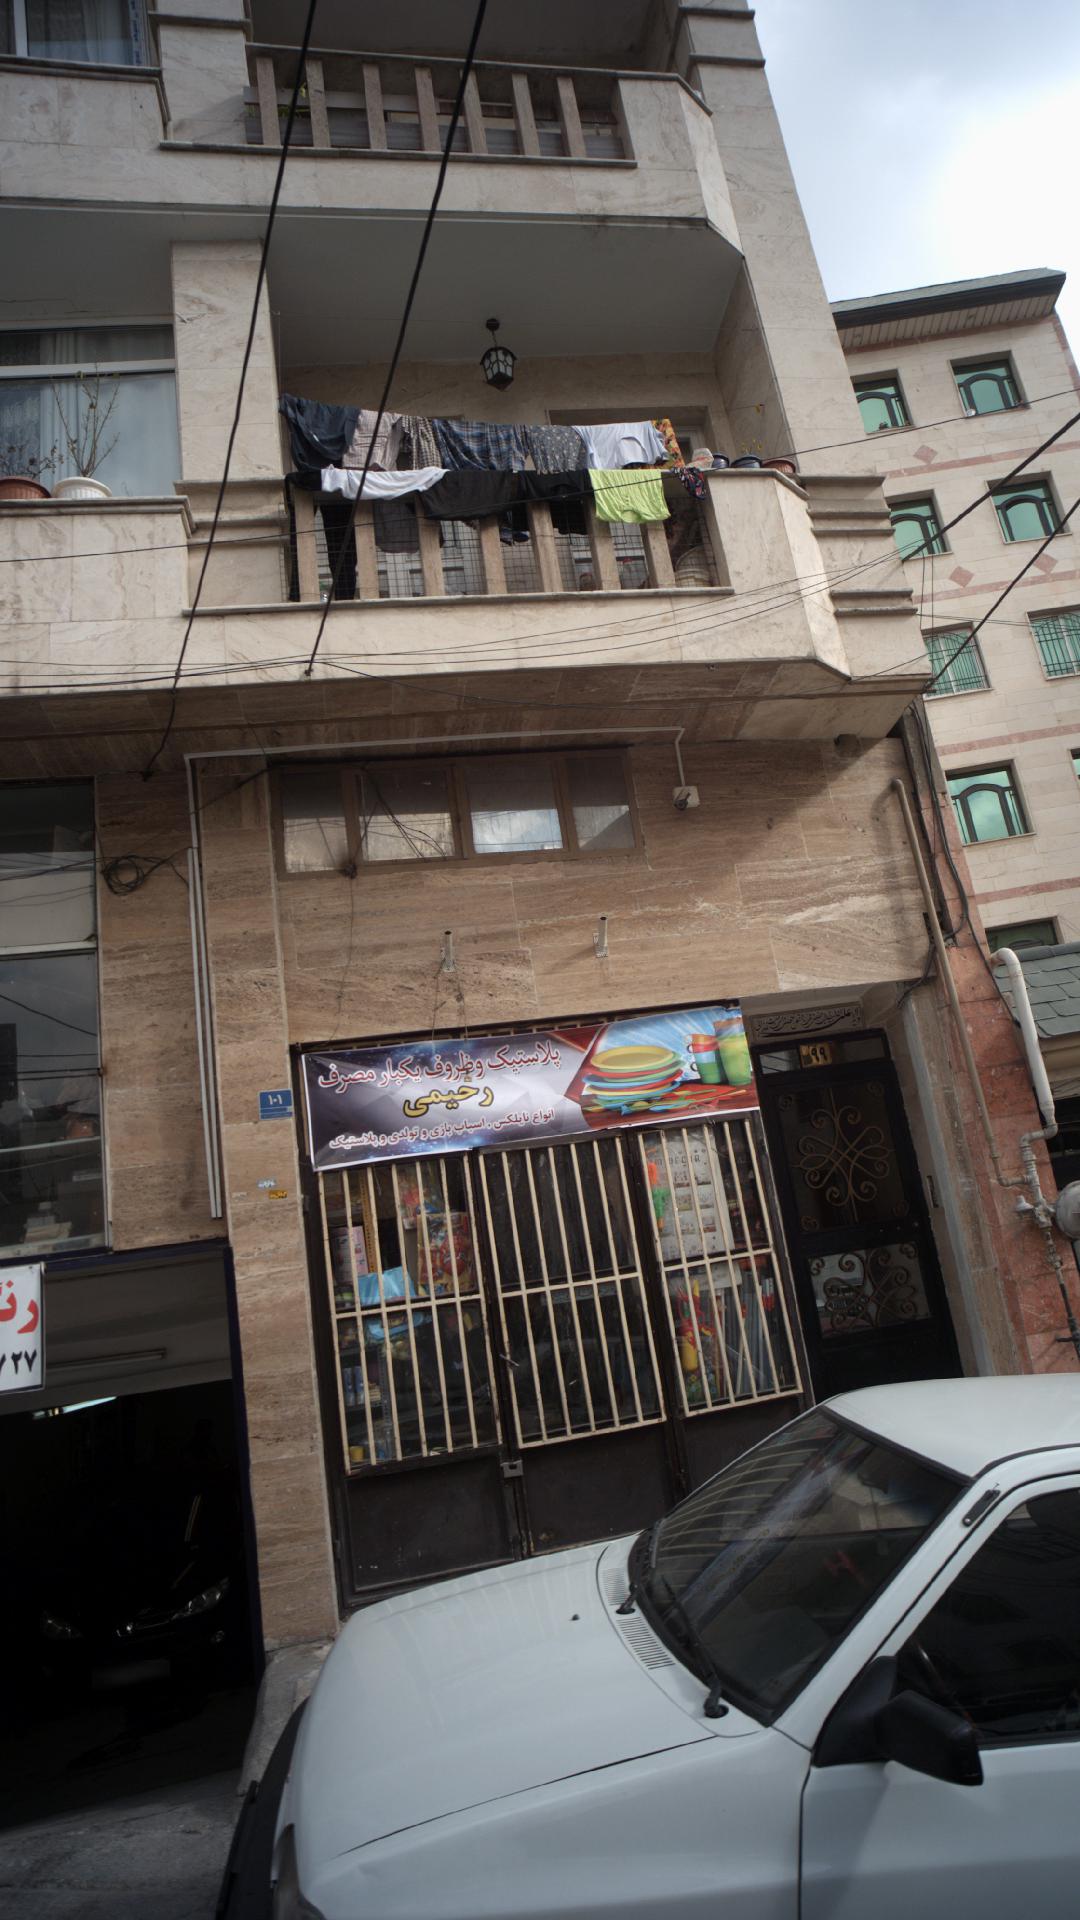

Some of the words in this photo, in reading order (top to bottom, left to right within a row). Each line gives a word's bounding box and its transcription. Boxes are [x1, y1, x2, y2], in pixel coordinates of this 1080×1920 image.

[487, 1039, 561, 1073] پلاستیک
[318, 1063, 377, 1093] مصرف
[377, 1055, 421, 1087] یکبار
[268, 1094, 283, 1105] ۱۰۱
[403, 1085, 495, 1118] رحیمی
[453, 1117, 486, 1131] اسباب
[532, 1108, 555, 1124] انواع
[388, 1126, 419, 1145] تولدی
[419, 1128, 428, 1141] و
[430, 1121, 452, 1138] بازی
[329, 1131, 379, 1149] پلاستیک
[378, 1133, 386, 1146] و
[0, 1280, 39, 1334] رن
